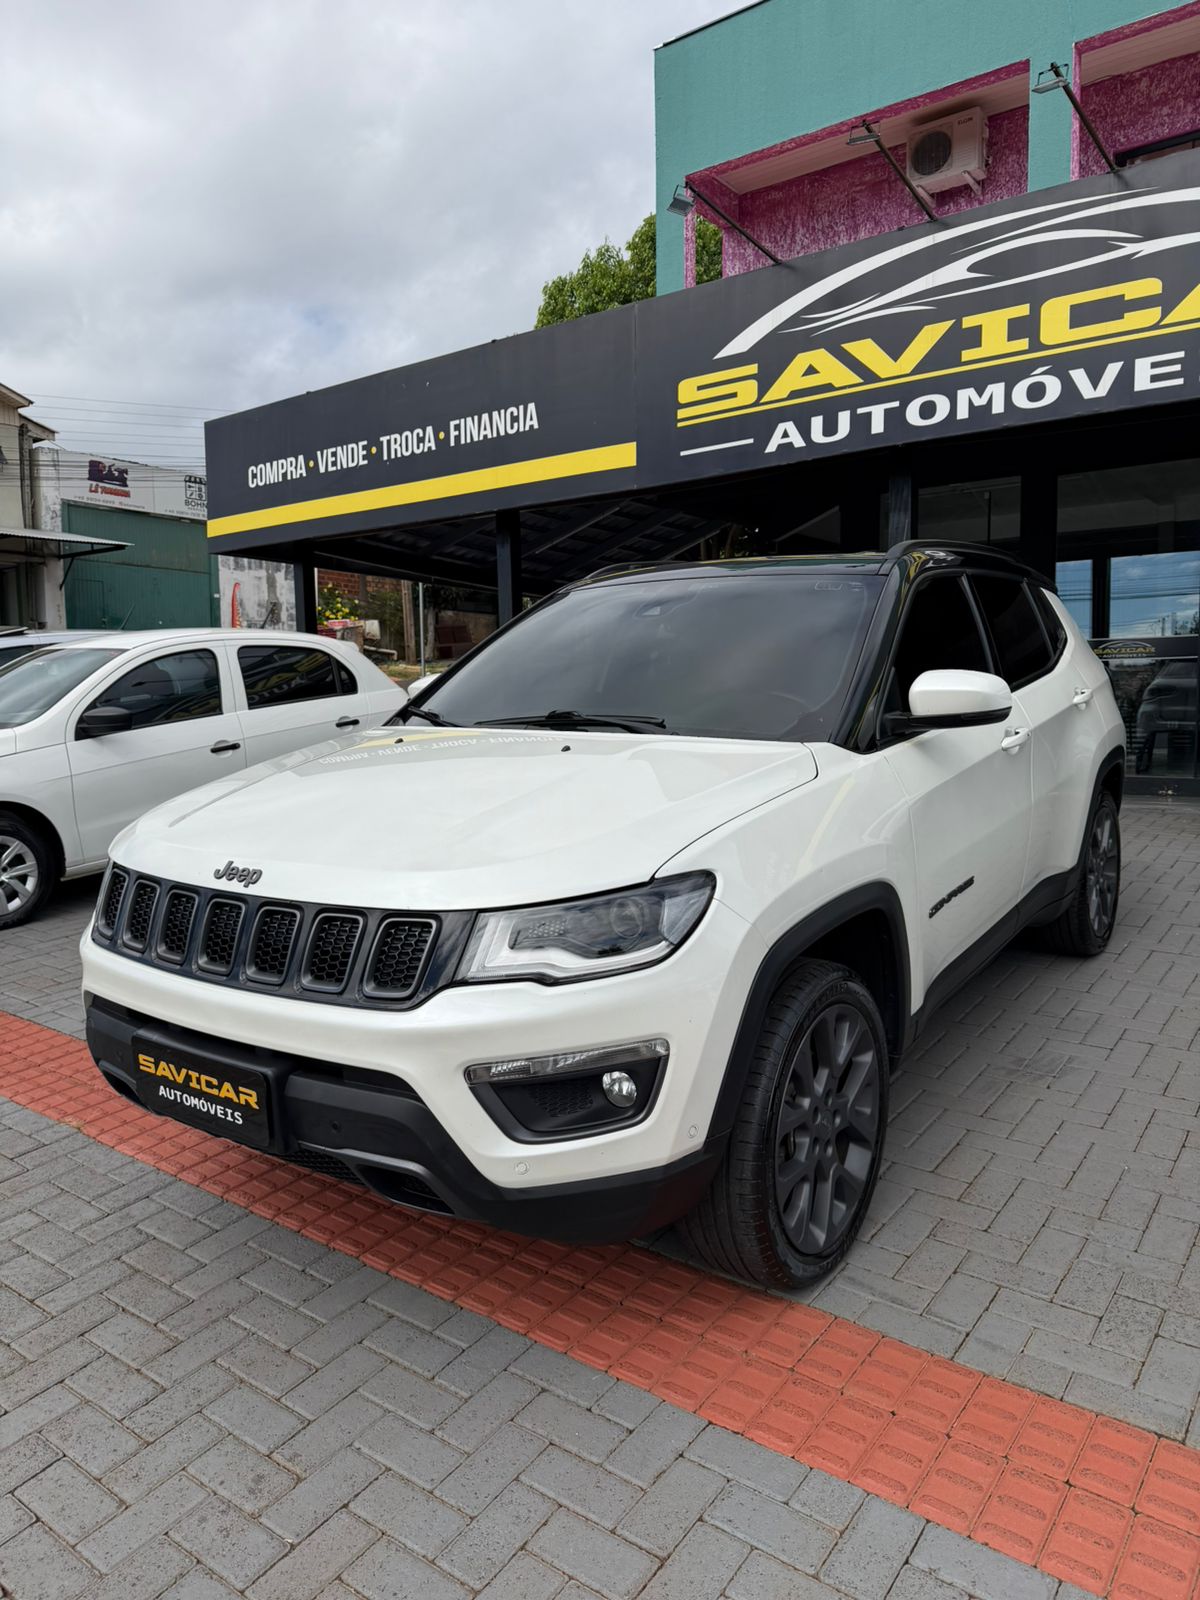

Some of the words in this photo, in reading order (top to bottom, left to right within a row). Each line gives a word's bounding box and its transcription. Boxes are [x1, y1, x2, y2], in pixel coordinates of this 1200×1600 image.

[248, 455, 307, 489] COMPRA
[316, 440, 369, 474] VENDE
[379, 425, 436, 461] TROCA
[449, 402, 539, 447] FINANCIA
[213, 860, 263, 888] Jeep
[138, 1053, 260, 1109] SAVICAR
[159, 1085, 244, 1125] AUTOMÓVEIS
